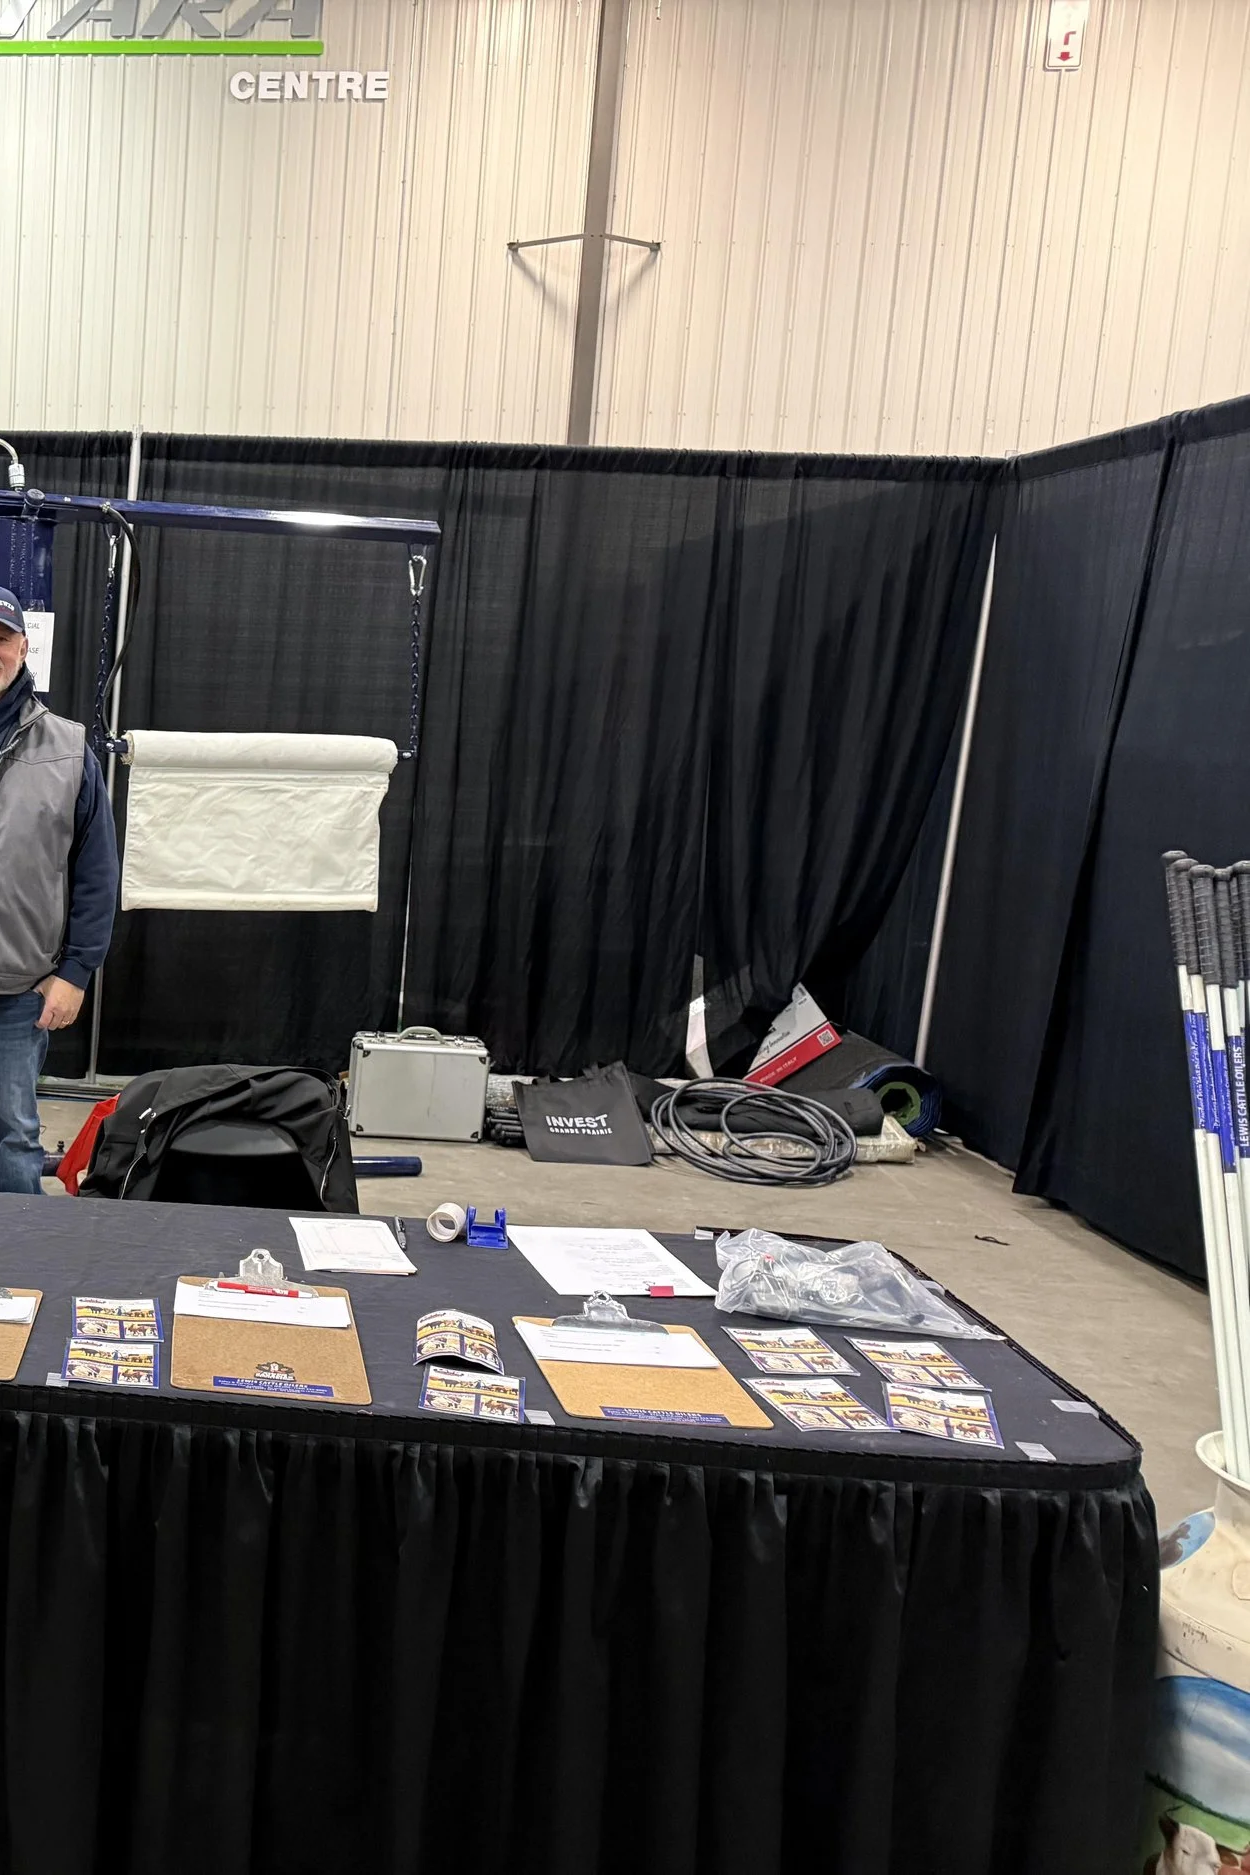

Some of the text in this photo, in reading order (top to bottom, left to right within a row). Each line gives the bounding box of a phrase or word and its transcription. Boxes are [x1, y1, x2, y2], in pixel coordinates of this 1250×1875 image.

[229, 71, 390, 101] CENTRE
[1233, 1046, 1250, 1147] LEWIS CATTLE OILERS
[545, 1113, 608, 1128] INVEST
[581, 1127, 613, 1136] PRAIRIE
